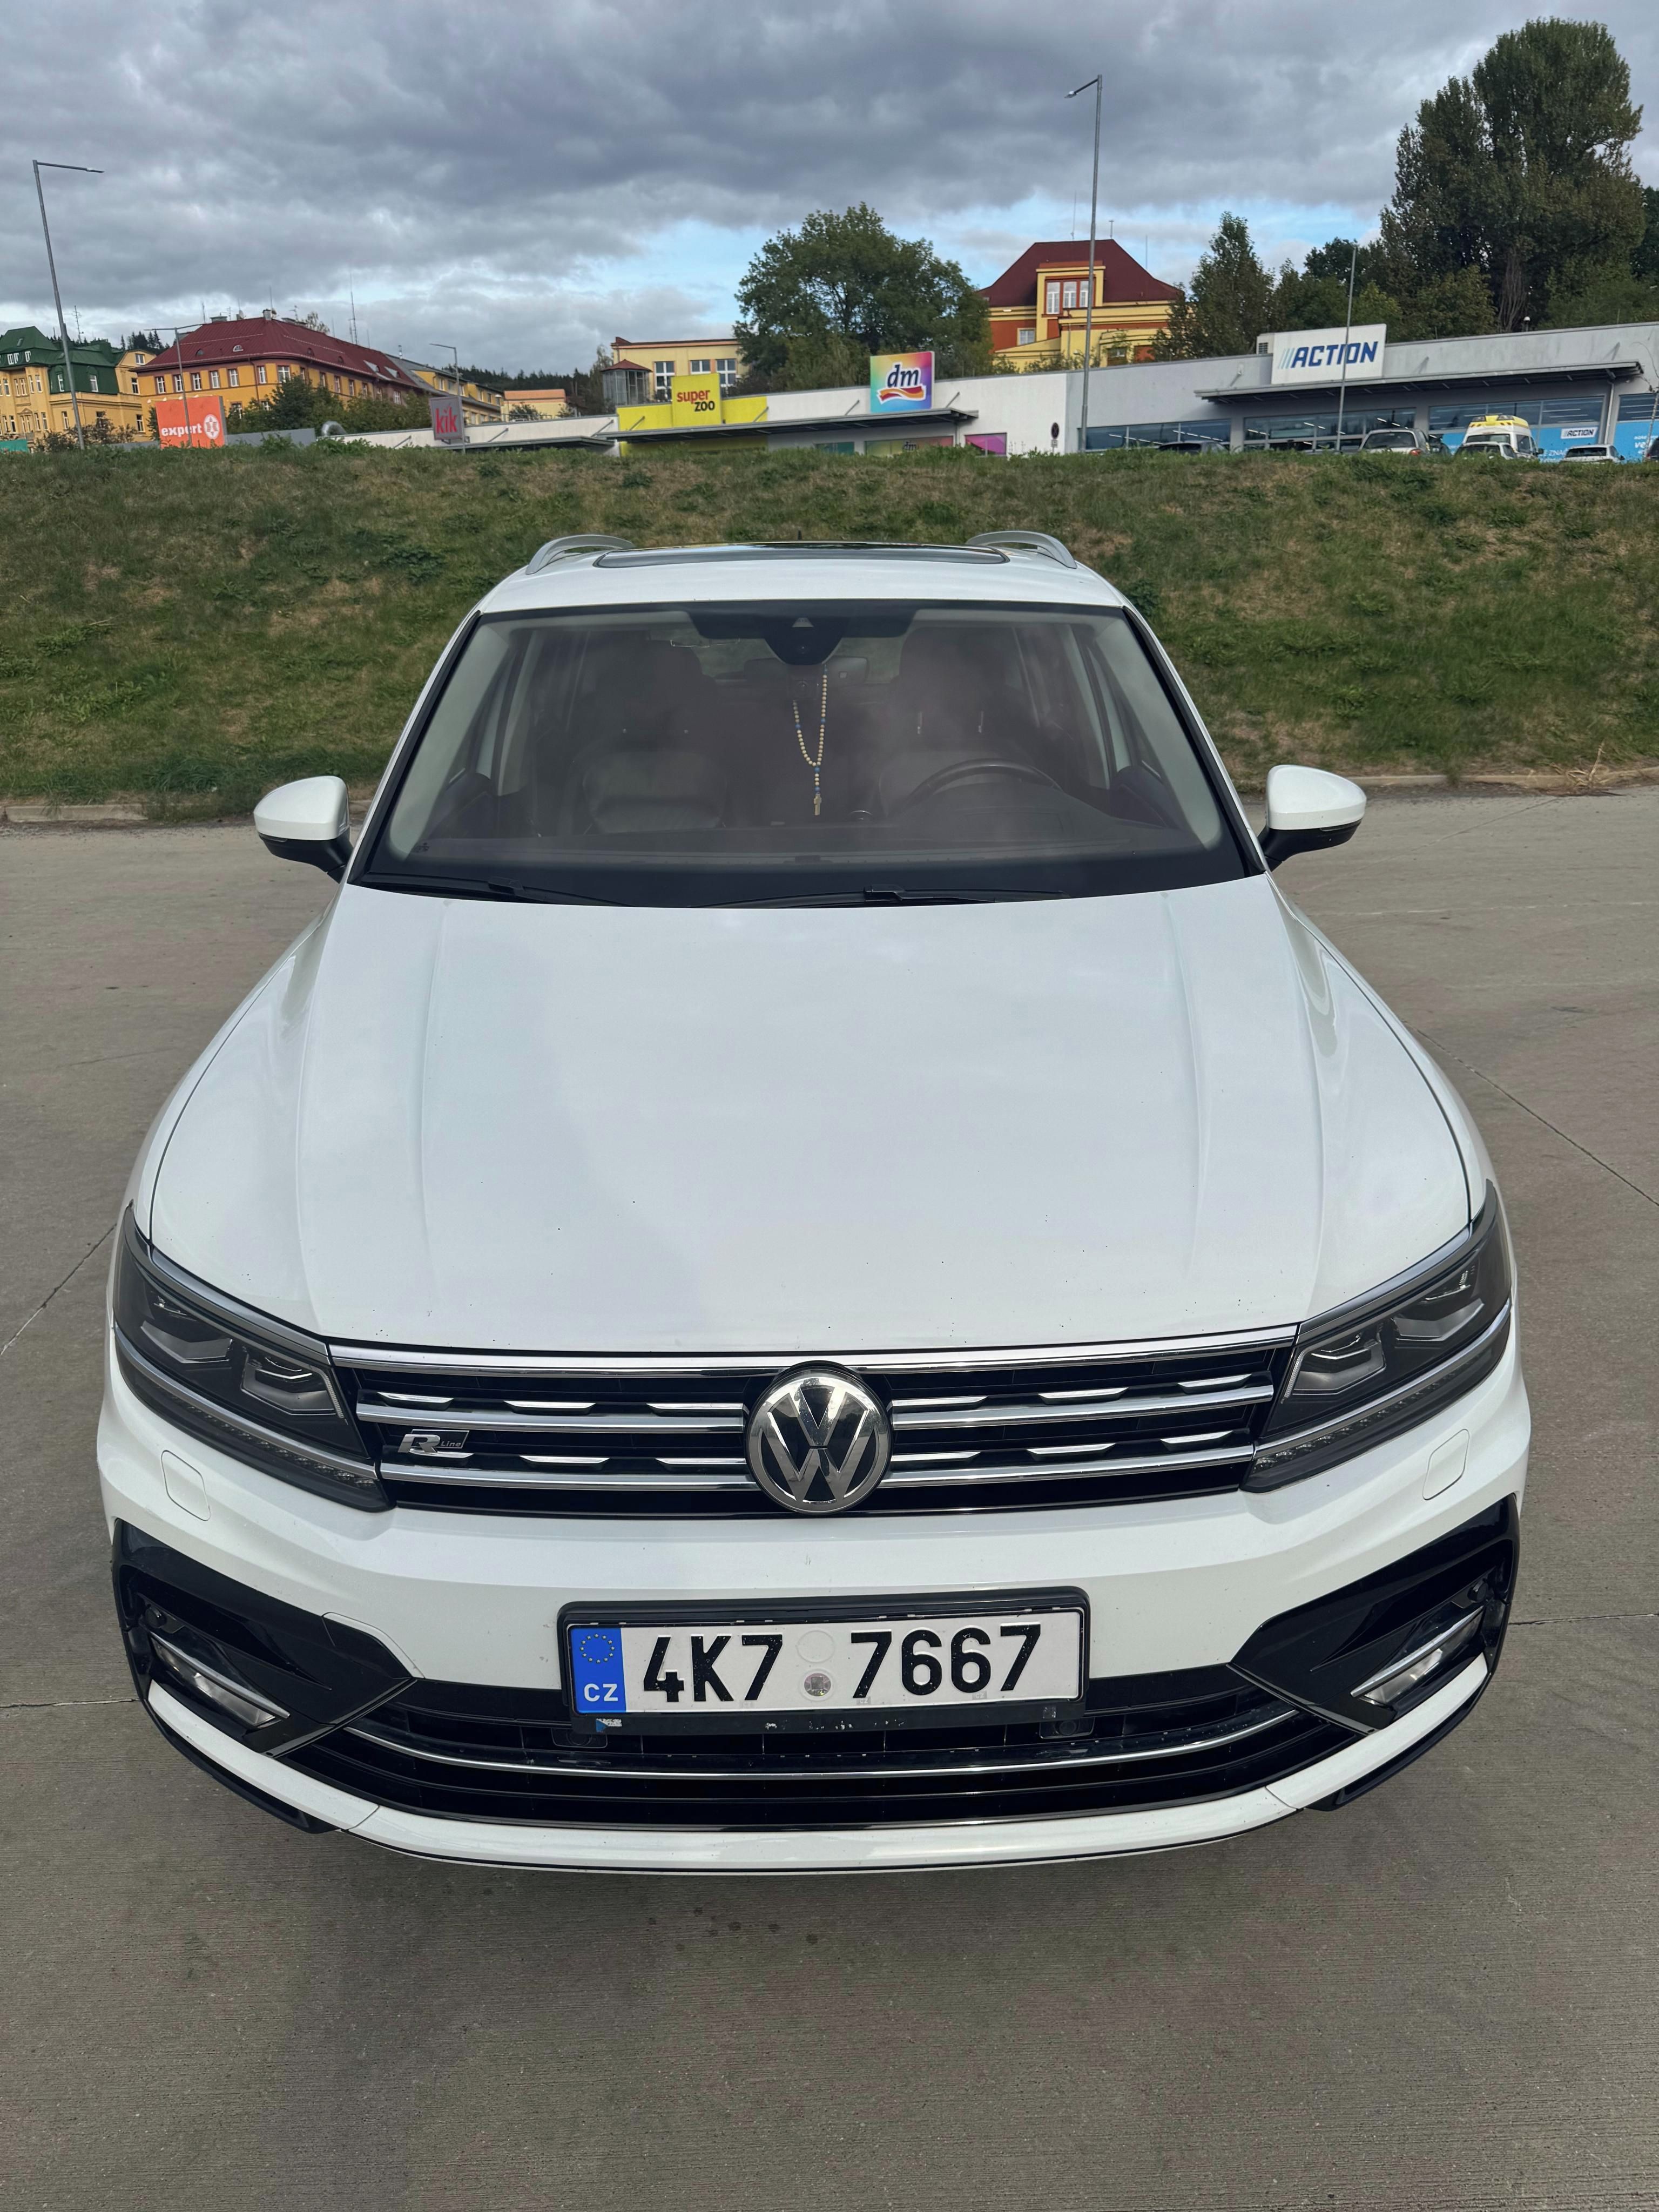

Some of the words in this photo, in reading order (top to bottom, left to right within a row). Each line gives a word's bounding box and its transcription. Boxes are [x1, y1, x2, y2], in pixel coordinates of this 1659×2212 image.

[1291, 341, 1378, 368] ACTION
[887, 364, 919, 388] dm
[677, 390, 710, 404] super
[435, 406, 457, 434] kik
[397, 1434, 440, 1453] R
[583, 1683, 618, 1702] CZ
[643, 1634, 783, 1702] 4K7
[851, 1621, 1041, 1698] 7667
